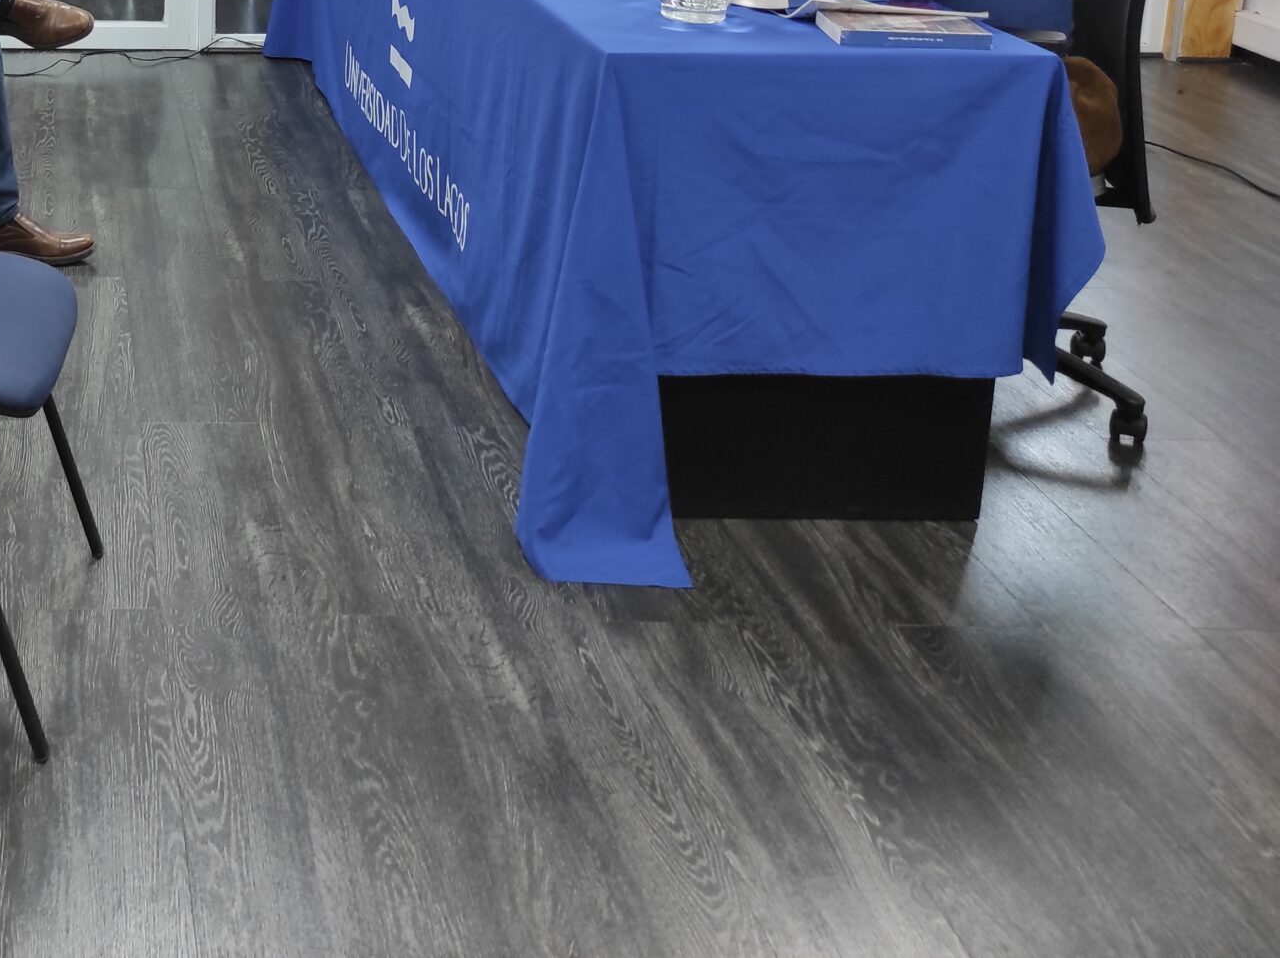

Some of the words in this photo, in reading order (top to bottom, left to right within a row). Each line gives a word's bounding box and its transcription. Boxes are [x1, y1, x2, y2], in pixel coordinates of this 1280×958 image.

[344, 40, 399, 149] UNIVERSIDAD
[400, 109, 412, 174] DE
[413, 129, 434, 202] LOS
[436, 156, 470, 252] LAGOS
